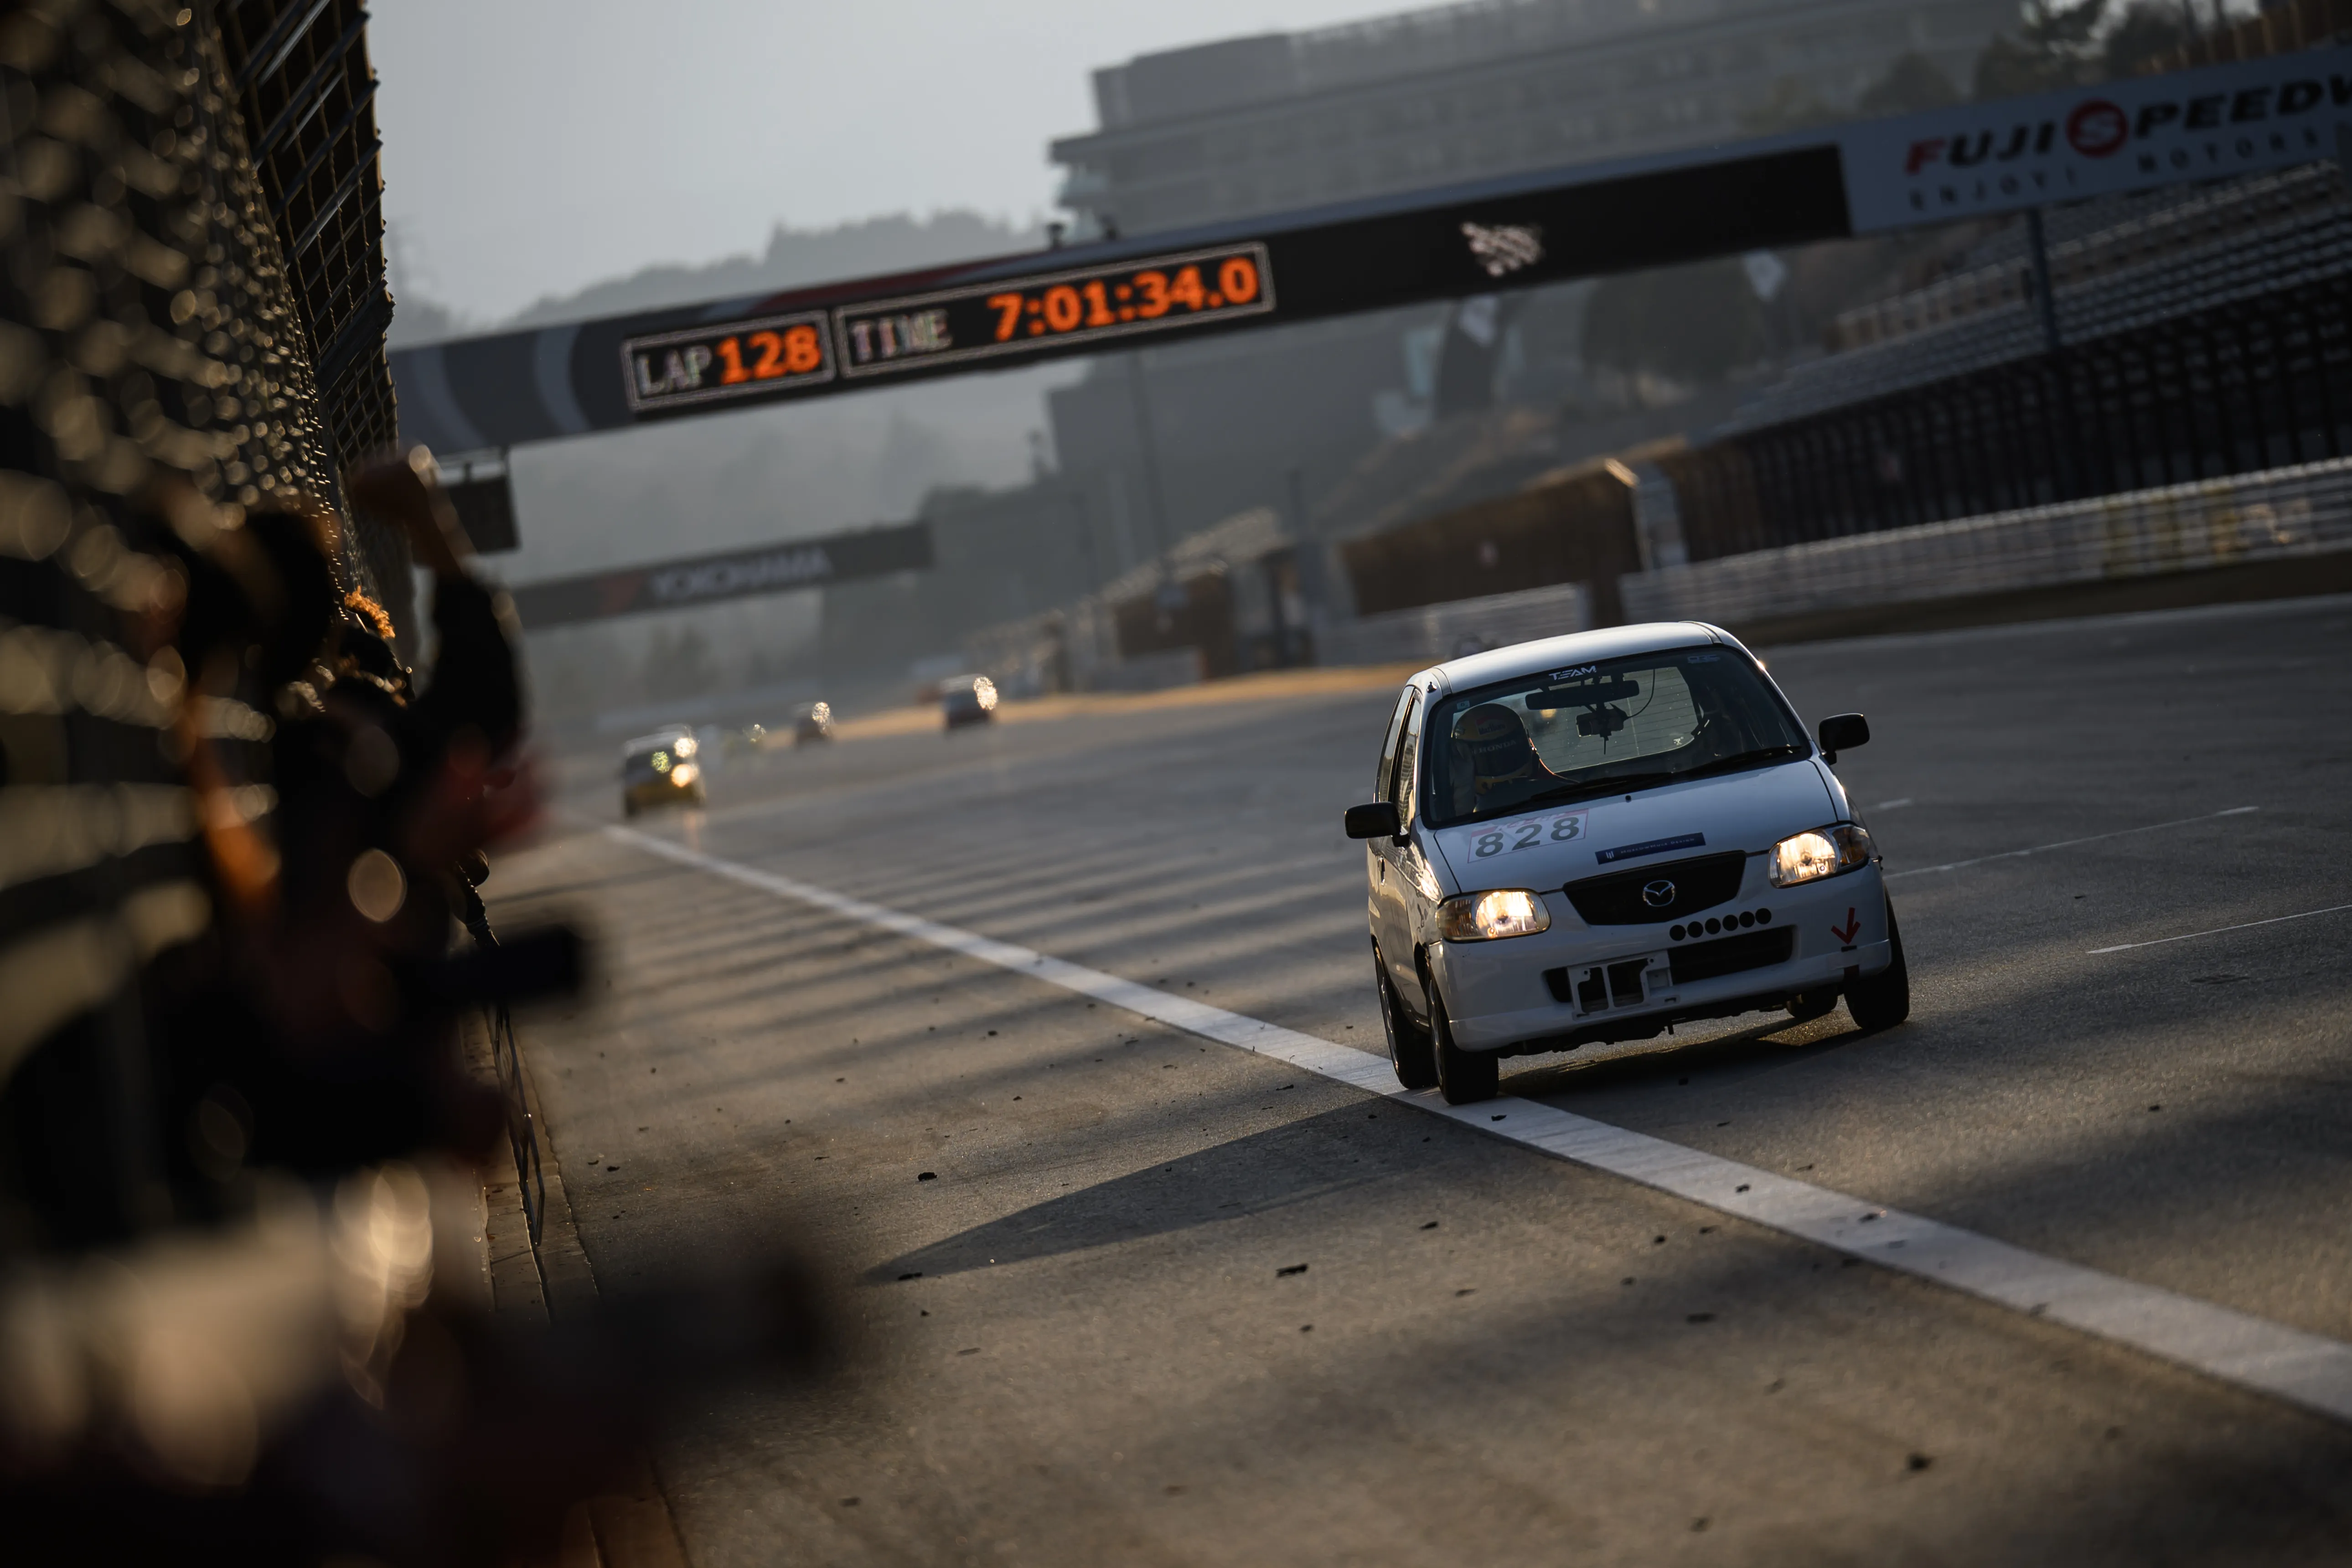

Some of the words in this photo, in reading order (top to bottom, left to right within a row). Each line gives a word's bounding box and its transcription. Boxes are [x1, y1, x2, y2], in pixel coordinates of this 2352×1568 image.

[1905, 120, 2057, 176] FUJI
[849, 309, 954, 363] TIME
[988, 257, 1259, 341] 7:01:34.0
[637, 346, 712, 396] LAP
[716, 325, 821, 386] 128
[1549, 665, 1597, 680] TEAM
[1478, 739, 1516, 753] HONDA
[1475, 817, 1579, 857] 828
